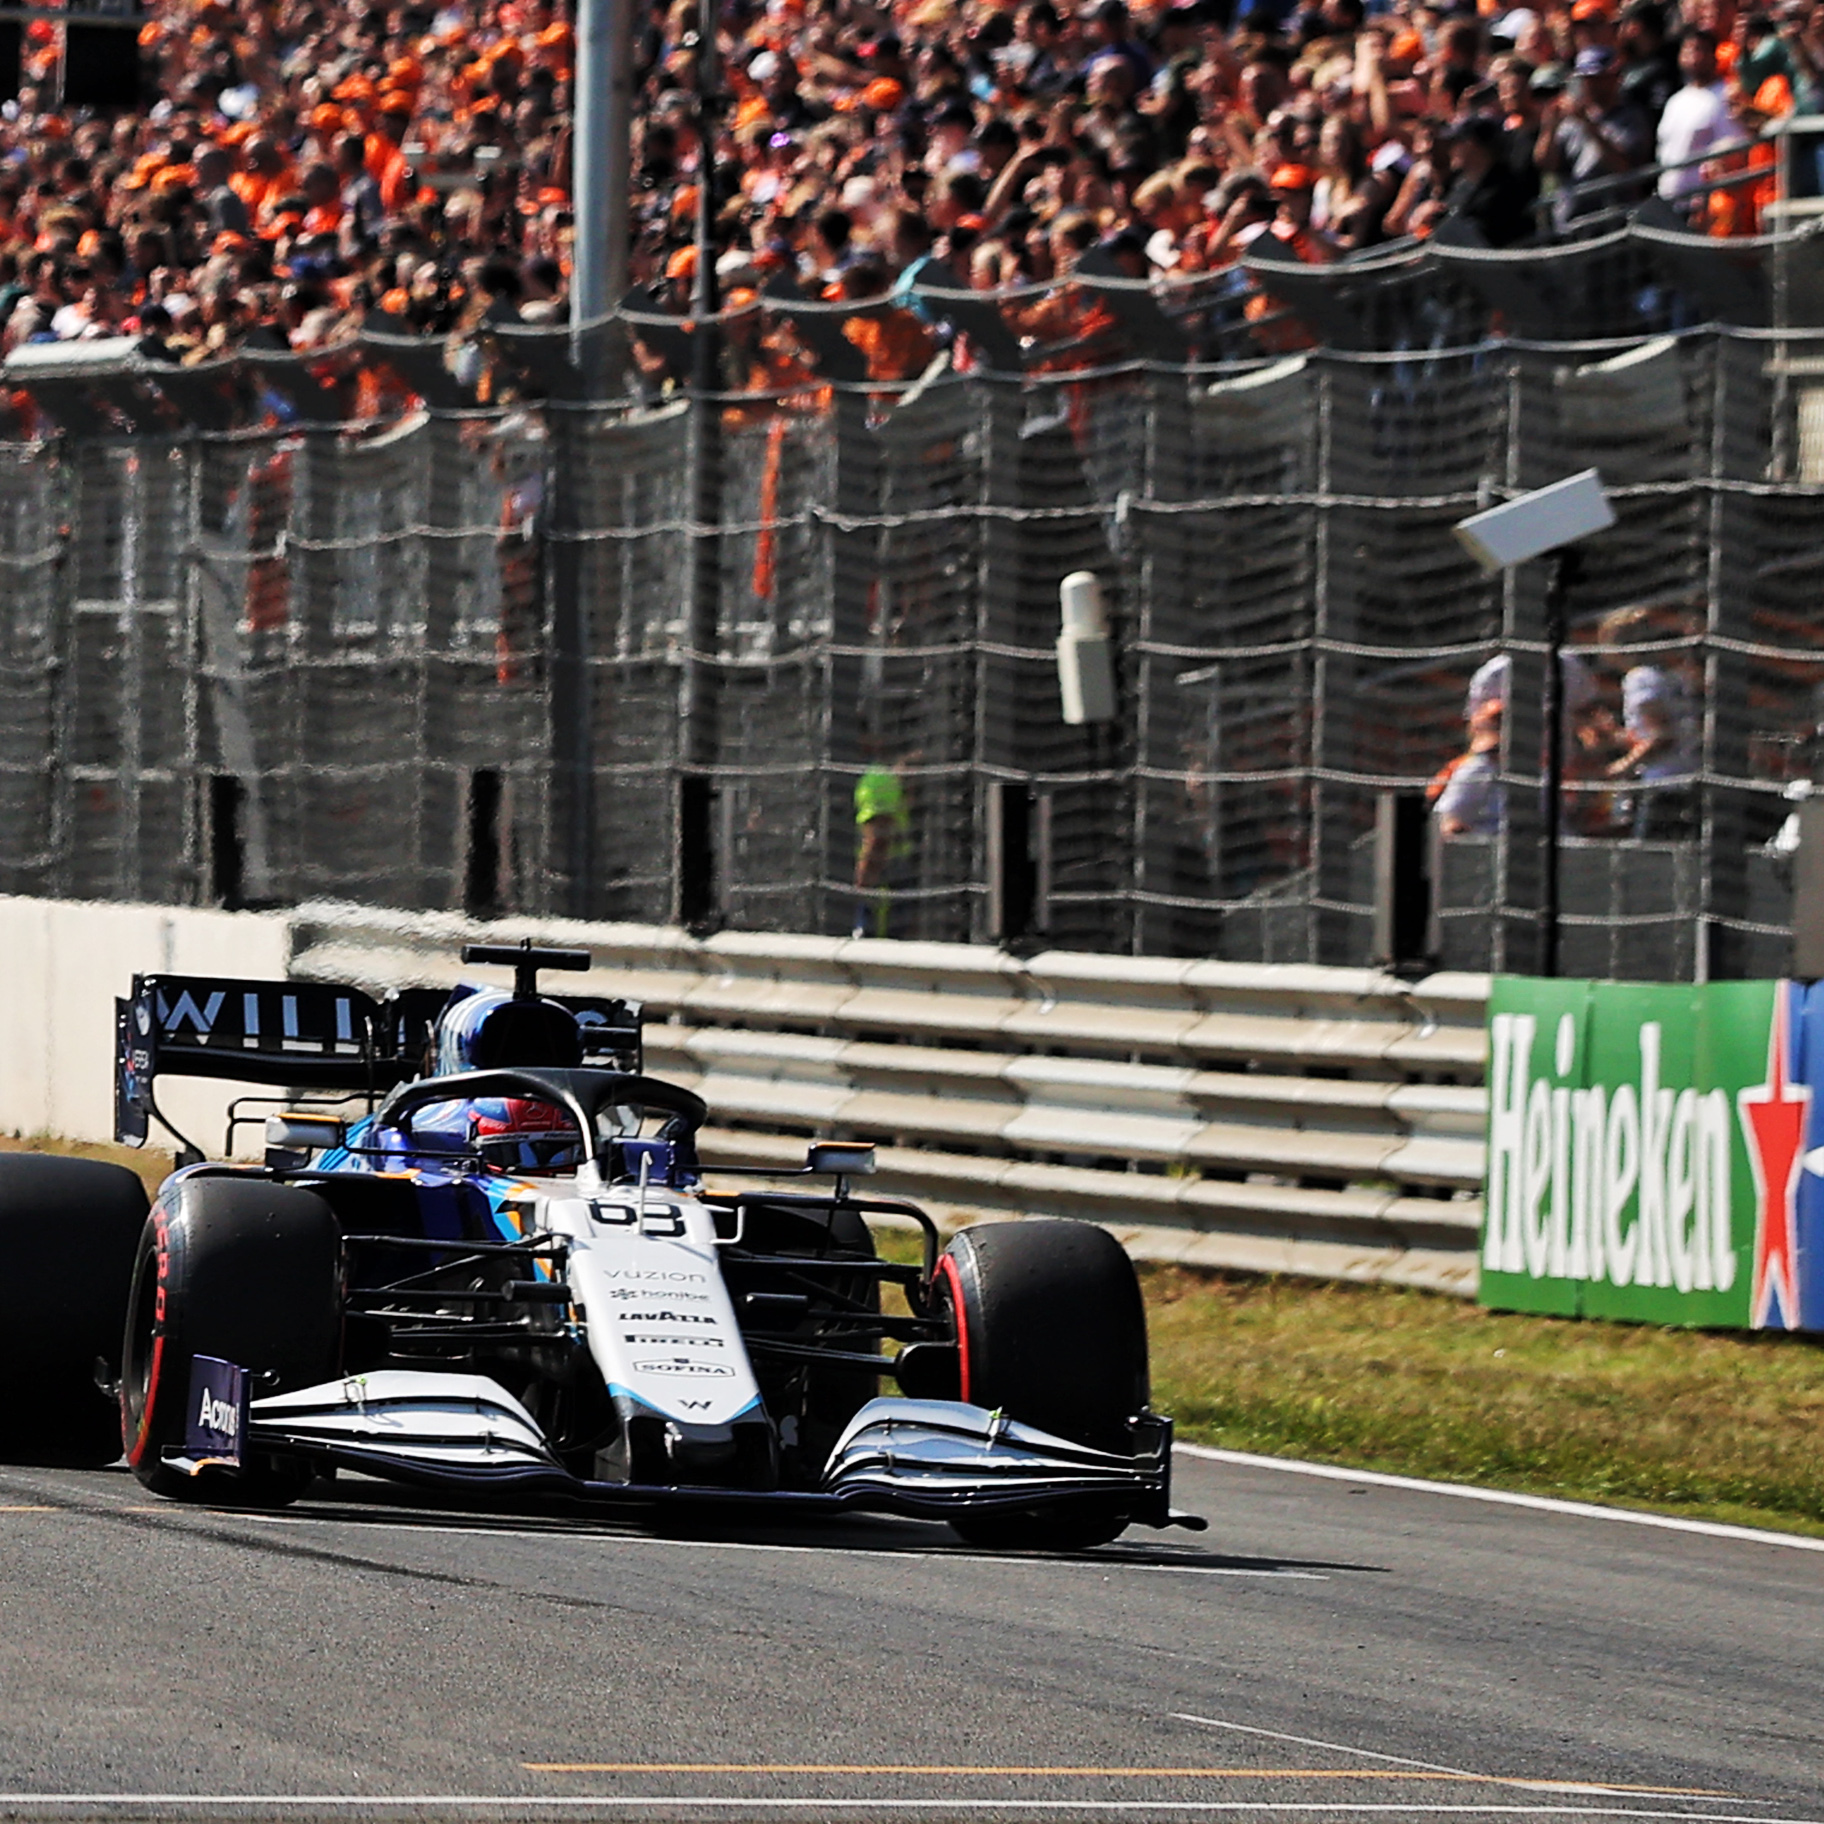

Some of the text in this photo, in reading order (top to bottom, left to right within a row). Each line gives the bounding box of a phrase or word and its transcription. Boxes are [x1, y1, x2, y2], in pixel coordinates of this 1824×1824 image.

[1484, 1012, 1737, 1293] Heineken
[589, 1203, 687, 1238] 63
[642, 1364, 728, 1375] SOFINA
